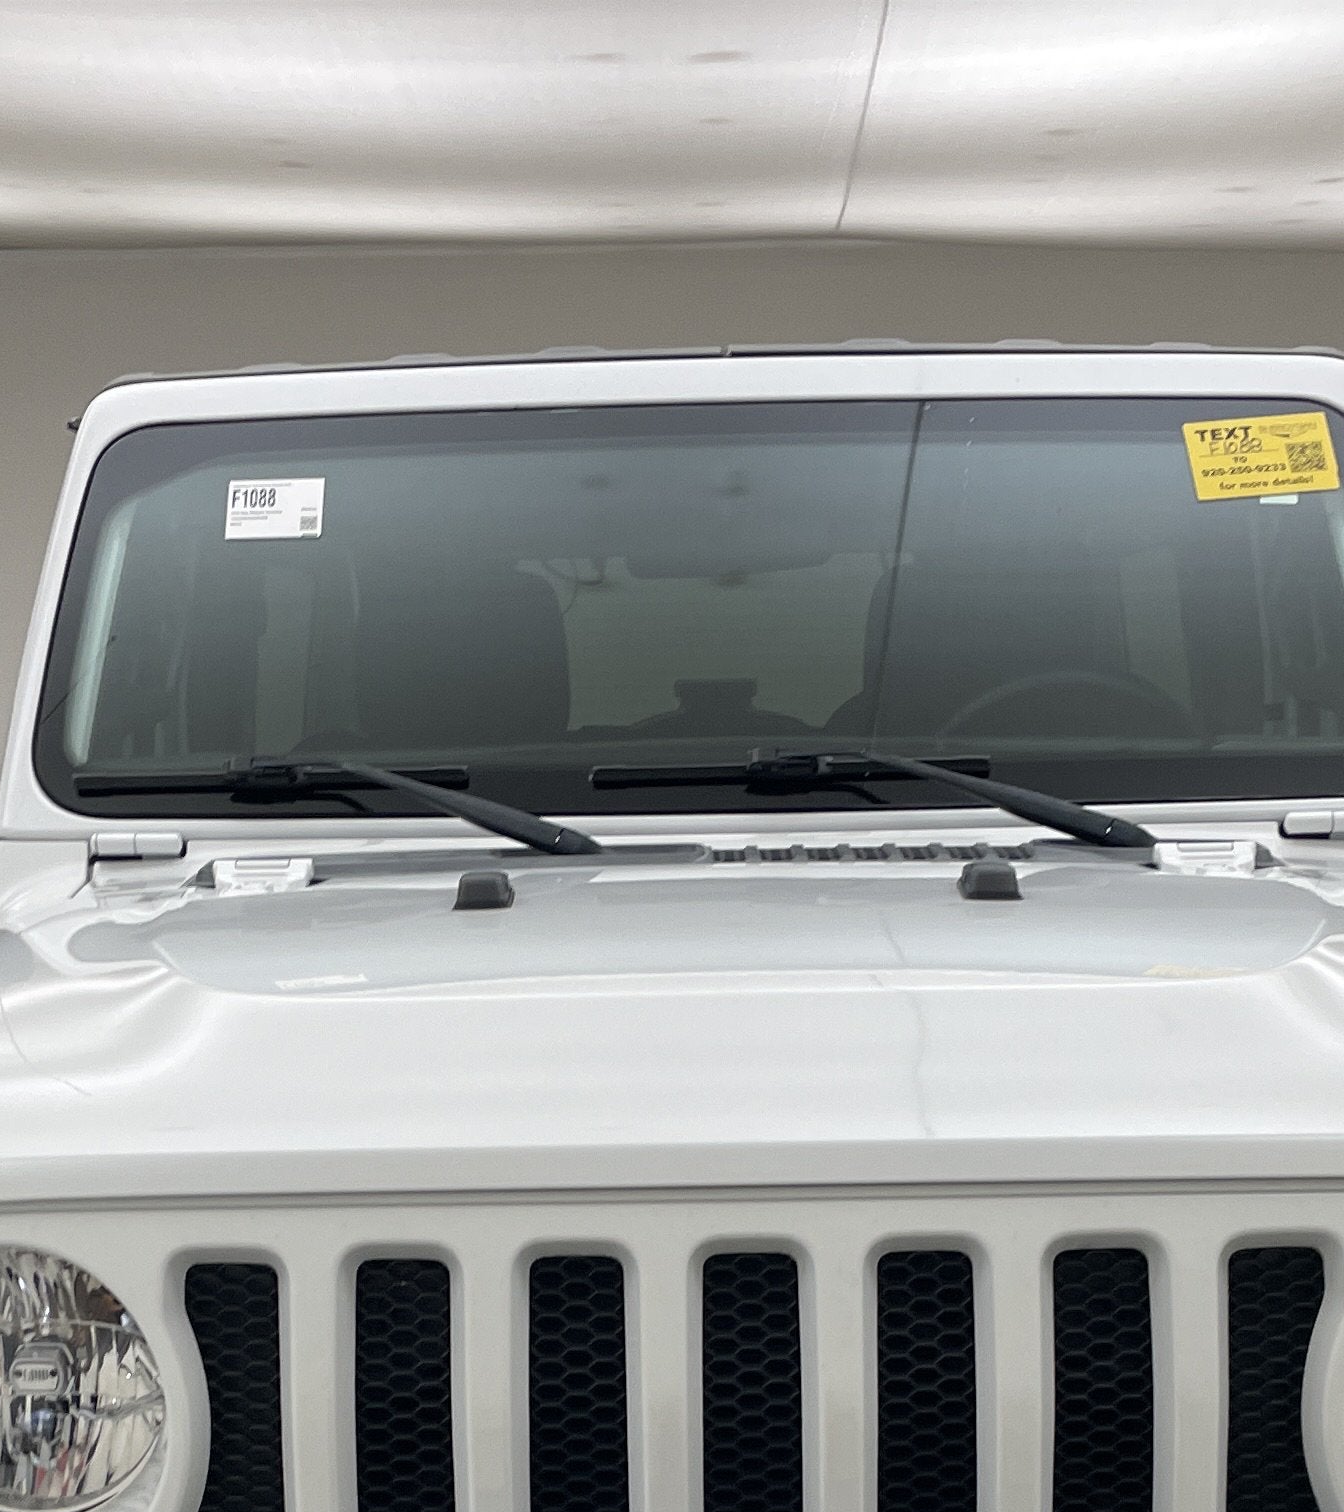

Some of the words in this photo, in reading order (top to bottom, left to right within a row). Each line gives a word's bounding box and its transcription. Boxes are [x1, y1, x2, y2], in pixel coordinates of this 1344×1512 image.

[1194, 425, 1252, 442] TEXT
[1219, 481, 1236, 490] for
[1239, 480, 1269, 489] more
[231, 488, 277, 509] F1088
